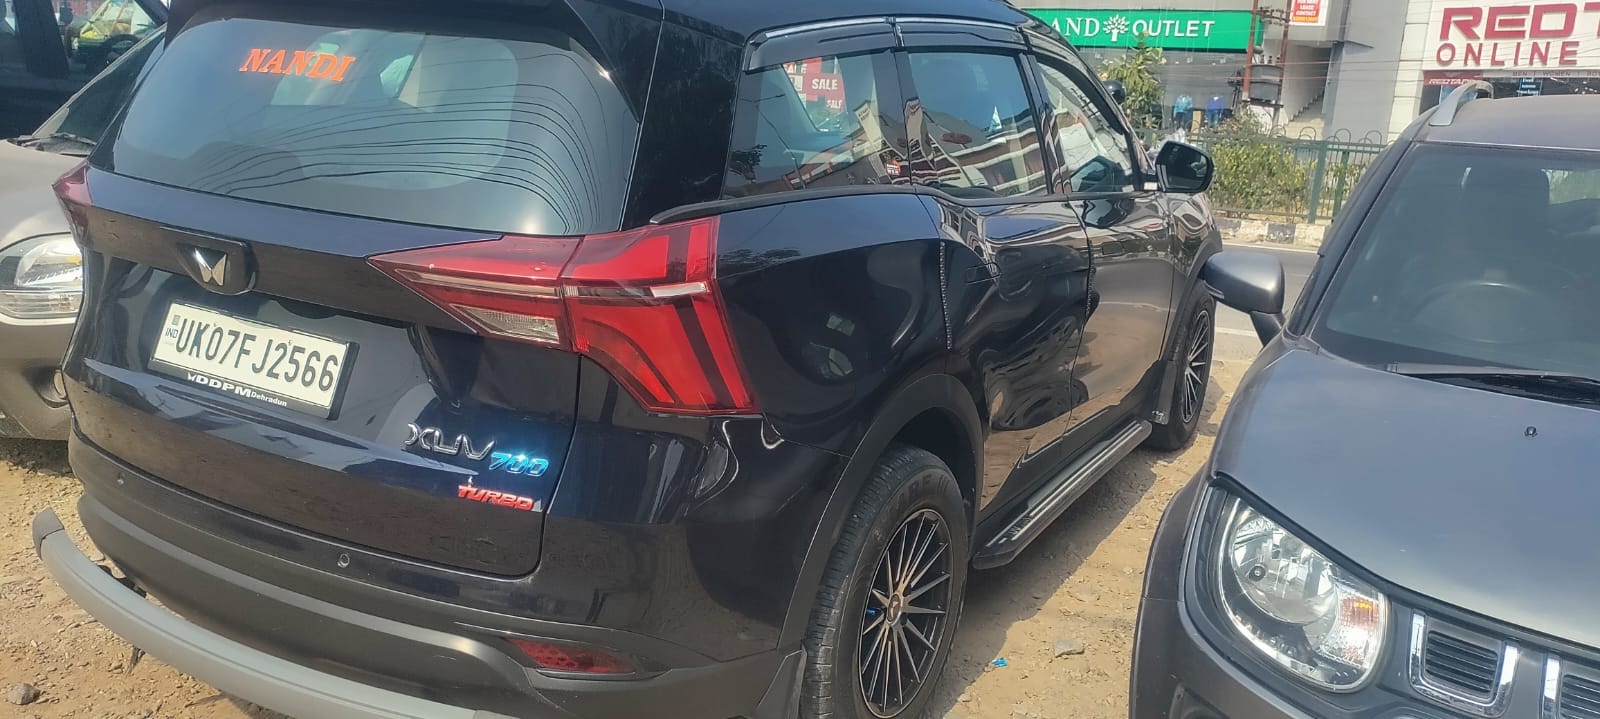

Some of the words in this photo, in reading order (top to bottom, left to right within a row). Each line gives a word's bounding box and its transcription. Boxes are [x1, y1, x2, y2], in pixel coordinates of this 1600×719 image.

[1132, 19, 1215, 38] OUTLET
[239, 48, 356, 82] NANDI
[1436, 41, 1580, 67] ONLINE
[811, 78, 838, 91] SALE
[165, 327, 179, 339] IND
[175, 317, 339, 392] UK07FJ2566
[251, 391, 288, 407] Dehradun
[404, 423, 497, 461] XUV
[488, 451, 550, 477] 700
[457, 484, 535, 512] TURBO
